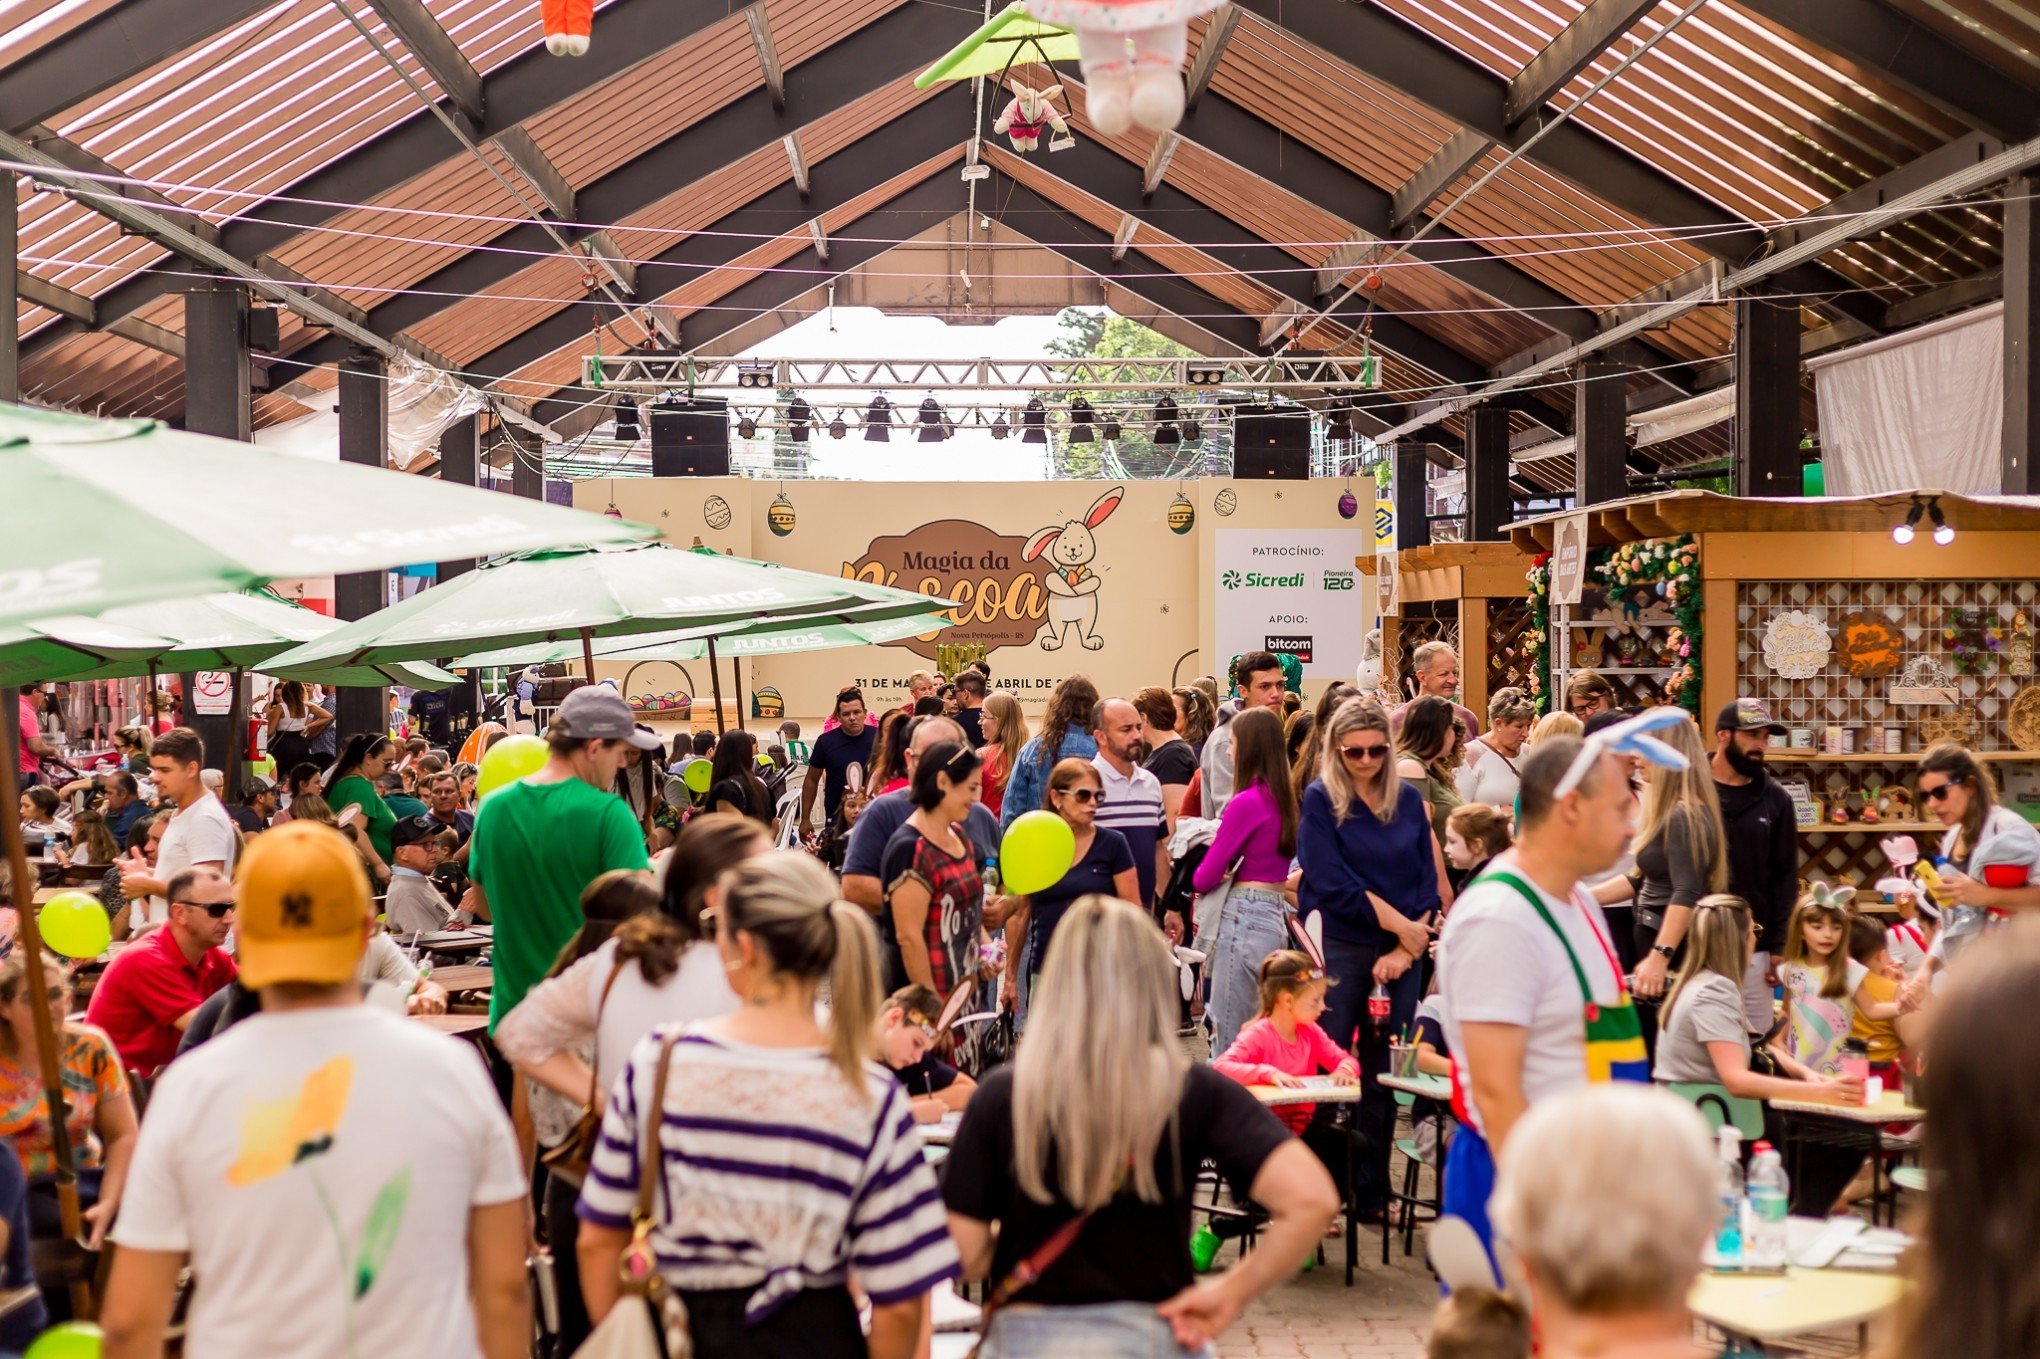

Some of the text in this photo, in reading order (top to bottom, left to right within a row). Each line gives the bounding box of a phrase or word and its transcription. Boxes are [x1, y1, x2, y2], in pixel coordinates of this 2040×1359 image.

[1252, 545, 1324, 556] PATROCÍNIO:
[903, 551, 1010, 575] Magia da
[1324, 569, 1354, 577] Pioneira
[1245, 573, 1304, 588] Sicredi
[663, 588, 785, 609] JUNTOS
[1269, 615, 1309, 624] APOIO:
[732, 632, 825, 649] JUNTOS
[972, 631, 1010, 640] Petrópolis
[1267, 638, 1311, 650] bitcom
[855, 678, 867, 688] 31
[872, 678, 889, 688] DE
[995, 678, 1032, 688] ABRIL
[1035, 678, 1052, 688] DE
